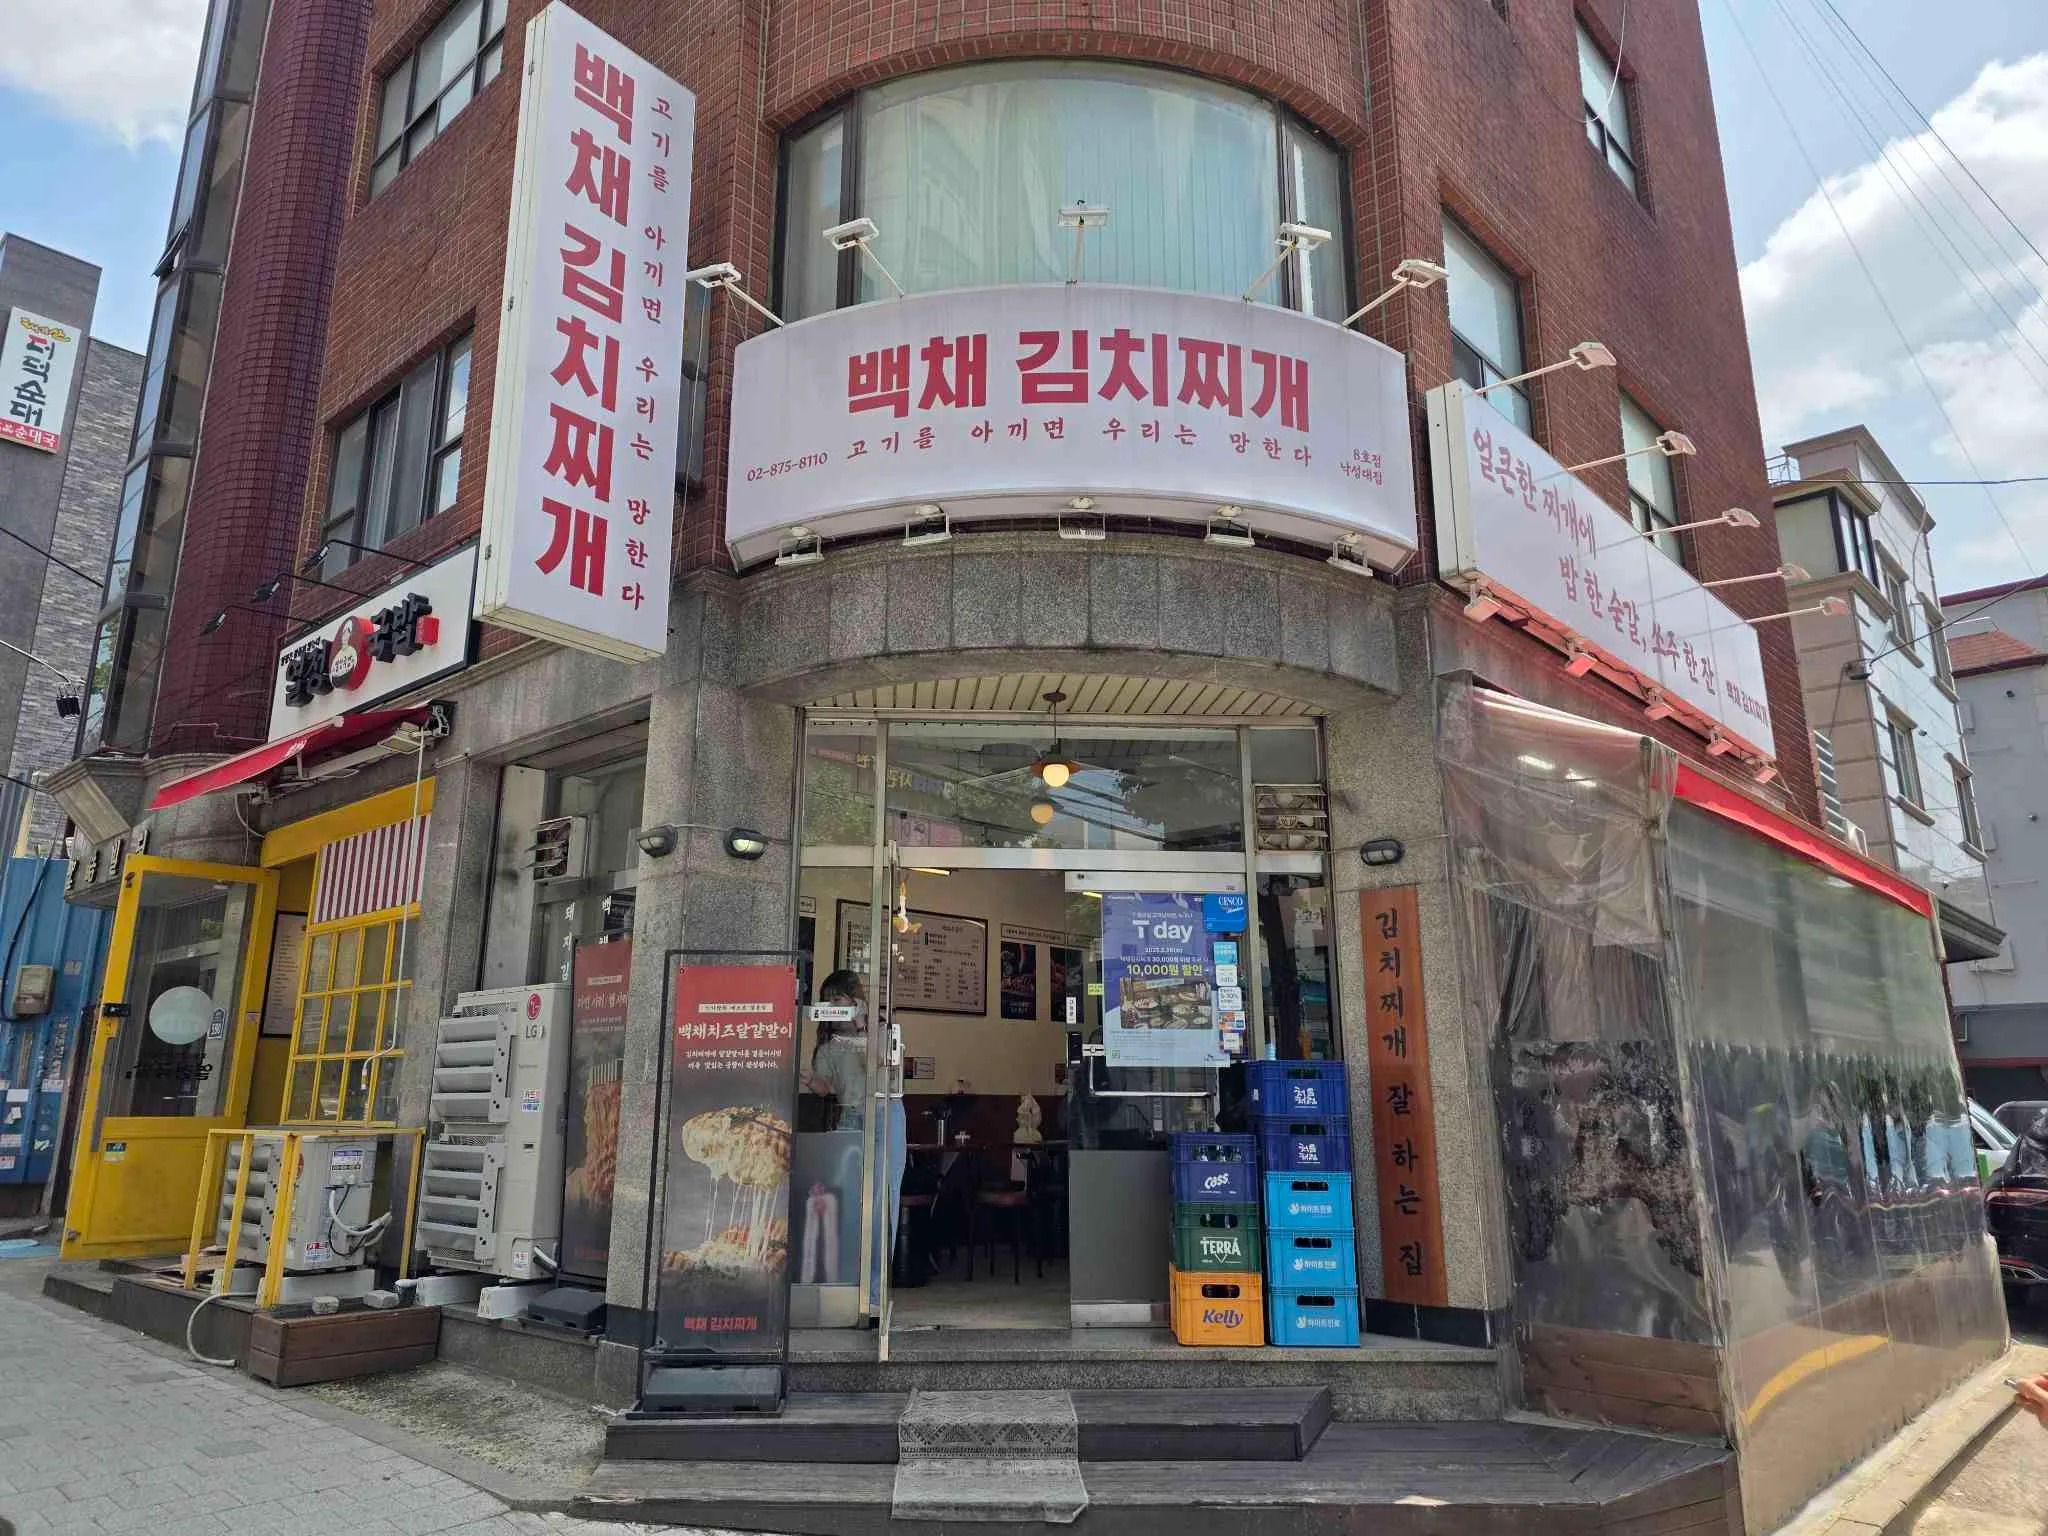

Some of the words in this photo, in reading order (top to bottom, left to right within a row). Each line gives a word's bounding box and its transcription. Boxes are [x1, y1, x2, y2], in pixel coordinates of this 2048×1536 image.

[648, 97, 673, 192] 고기를
[641, 224, 666, 324] 아끼면
[847, 333, 988, 417] 백채
[1015, 328, 1310, 433] 김치찌개
[630, 356, 660, 460] 우리는
[746, 451, 828, 483] 02-875-8110
[846, 426, 937, 459] 고기를
[971, 418, 1064, 442] 아끼면
[1102, 418, 1197, 447] 우리는
[1229, 430, 1311, 468] 망한다
[1473, 427, 1537, 513] 얼큰한
[1542, 486, 1597, 561] 찌개에
[622, 498, 651, 610] 망한다
[1559, 557, 1577, 602] 밥
[1583, 574, 1603, 619] 한
[1683, 639, 1699, 684] 한
[1701, 655, 1716, 695] 잔
[1218, 895, 1243, 906] CESCO
[1153, 921, 1193, 943] day
[1127, 964, 1179, 976] 10,000원
[1182, 964, 1203, 976] 할인
[526, 1025, 537, 1039] LG
[1376, 908, 1407, 1059] 김치찌개
[1400, 1242, 1424, 1276] 집
[1204, 1173, 1230, 1190] Cass
[1200, 1237, 1241, 1257] TERRA
[1203, 1308, 1243, 1328] Kelly
